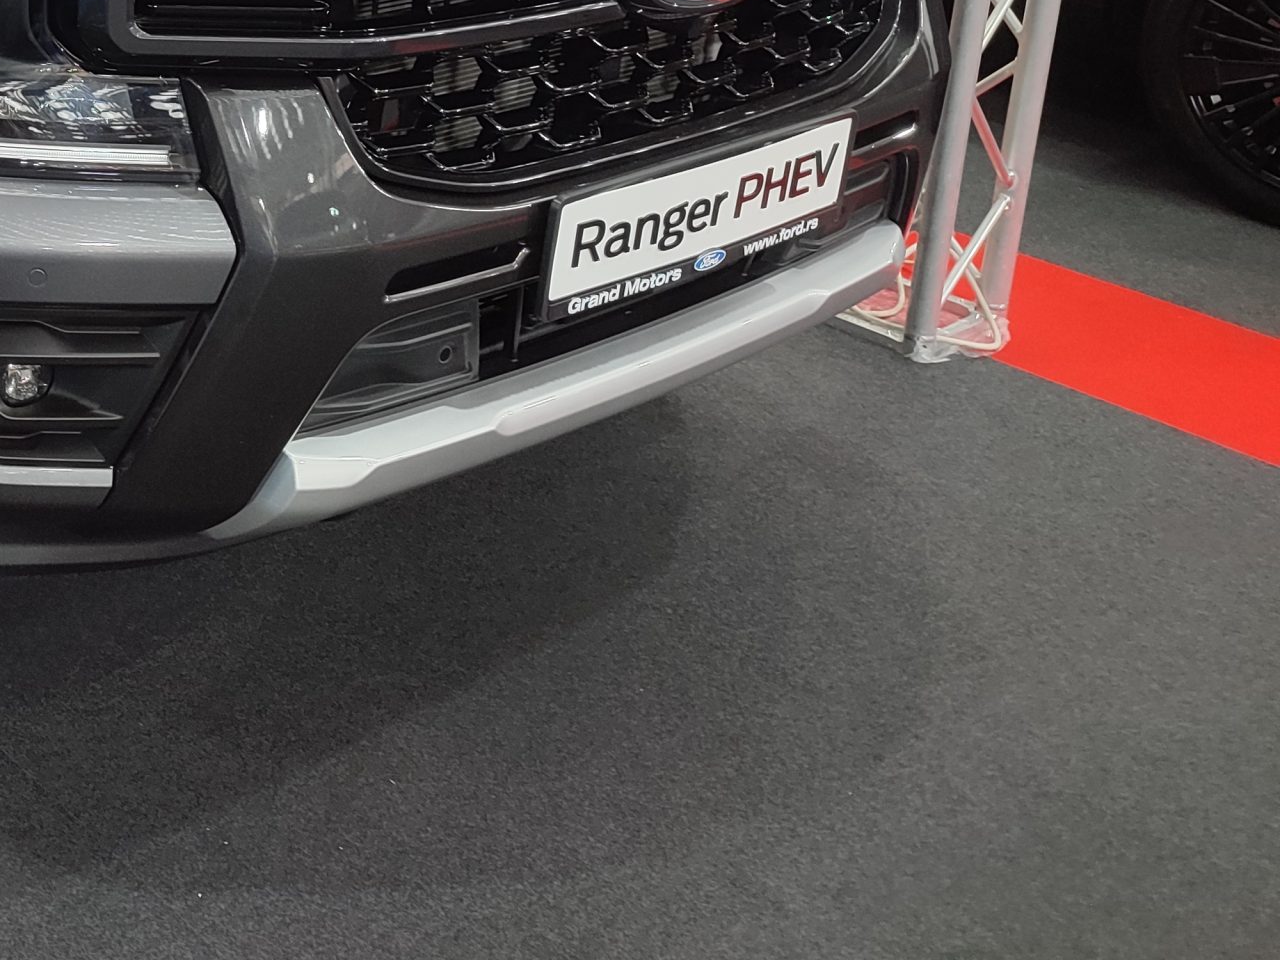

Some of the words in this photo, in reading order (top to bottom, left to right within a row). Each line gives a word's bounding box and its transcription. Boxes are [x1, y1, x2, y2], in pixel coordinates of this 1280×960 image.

[570, 189, 729, 269] Ranger
[733, 141, 840, 219] PHEV
[742, 217, 819, 257] www.ford.rs
[567, 285, 621, 315] Grand
[623, 266, 683, 298] Motors
